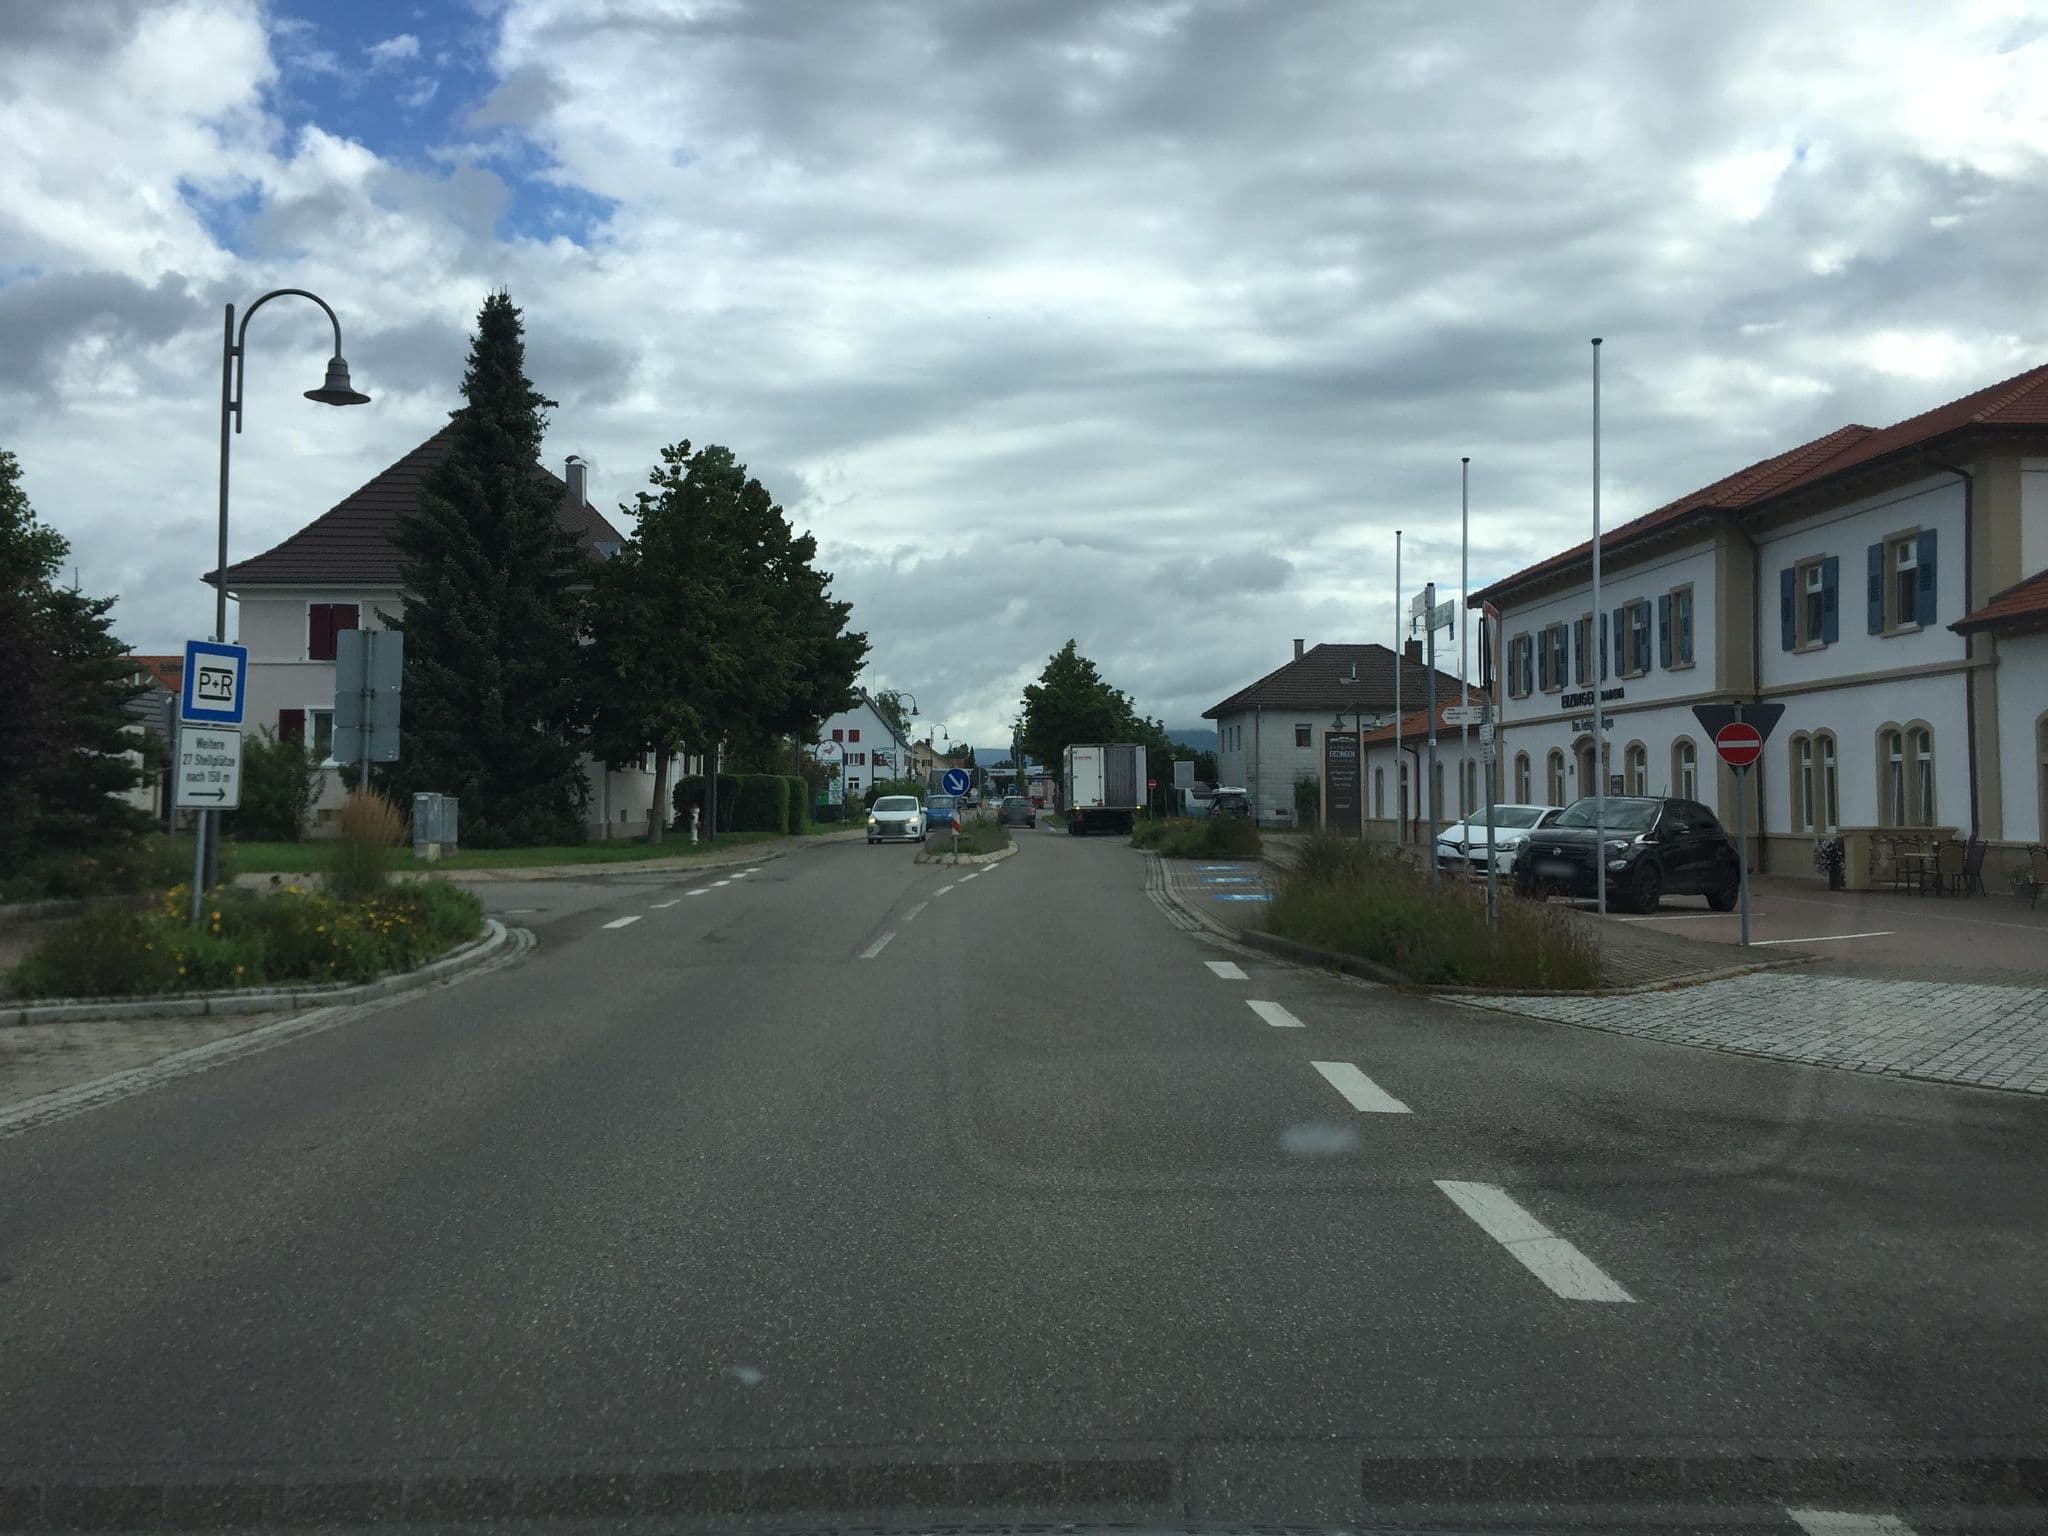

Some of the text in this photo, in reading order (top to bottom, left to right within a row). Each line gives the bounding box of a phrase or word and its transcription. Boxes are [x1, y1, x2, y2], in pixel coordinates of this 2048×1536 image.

[198, 673, 233, 696] P+R
[196, 737, 225, 750] Weitere
[183, 753, 193, 766] 27
